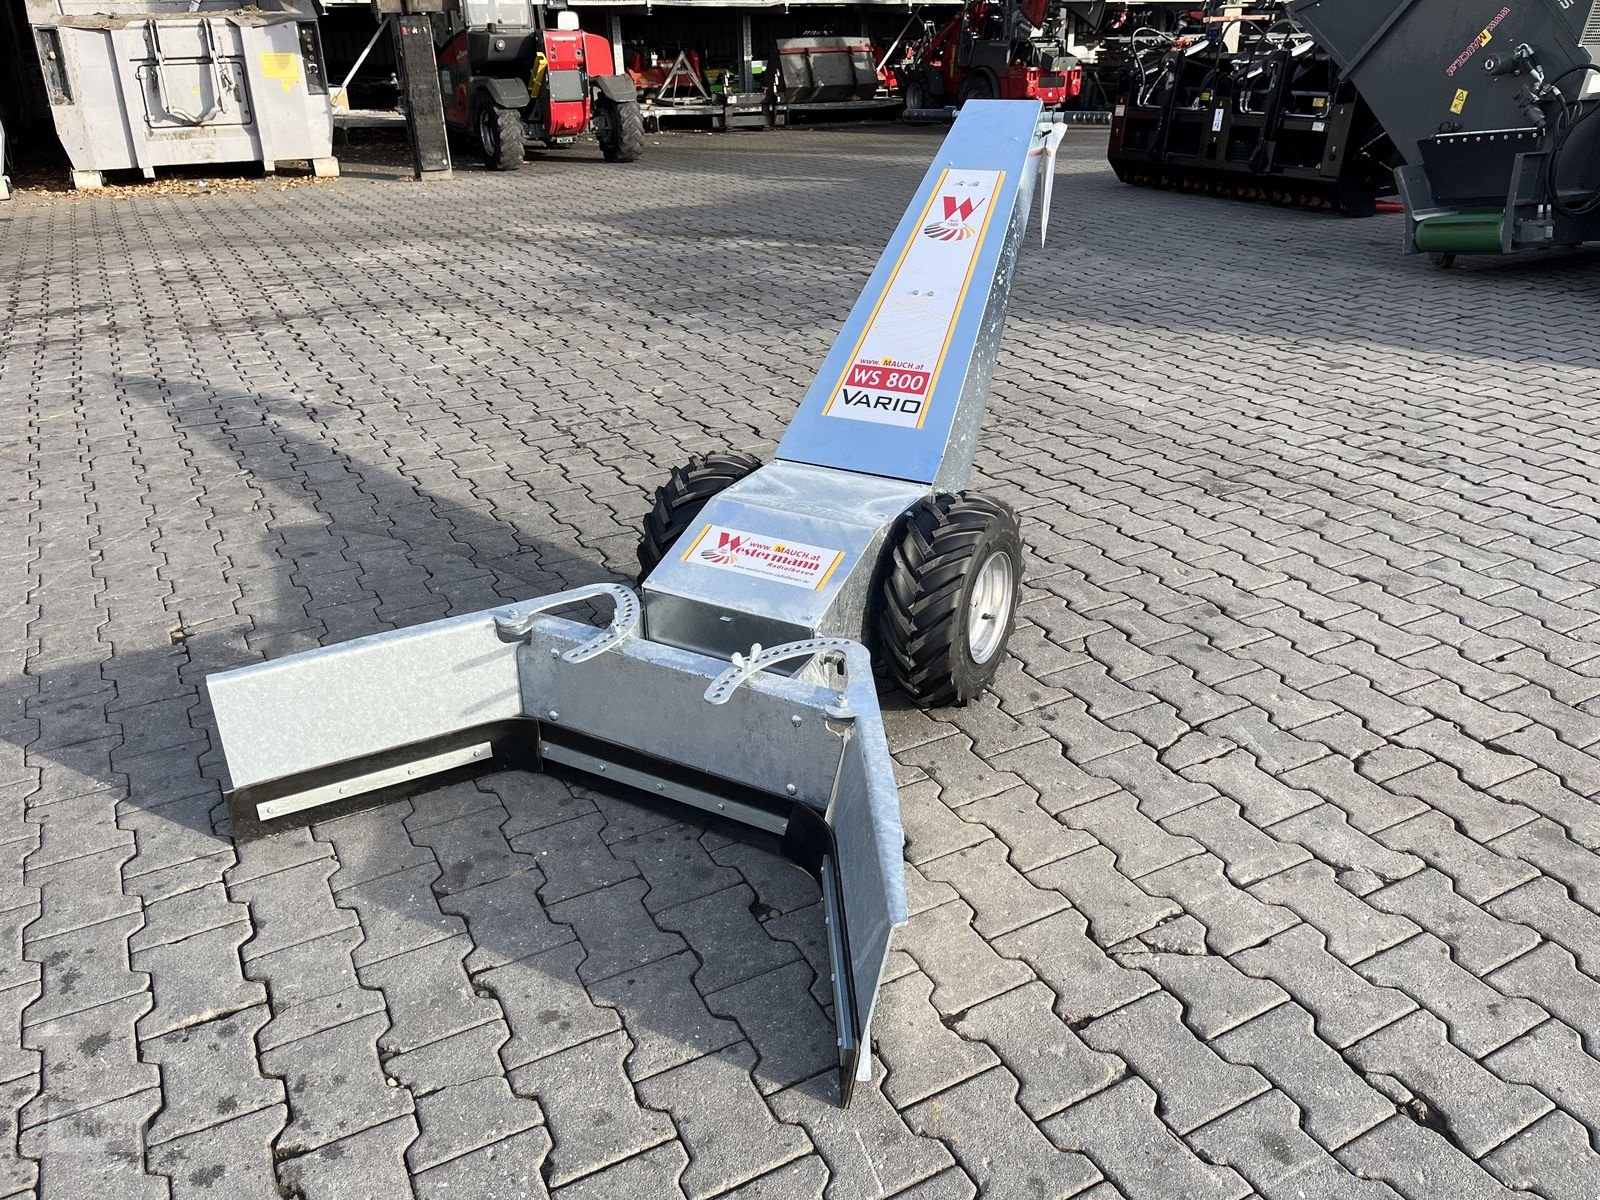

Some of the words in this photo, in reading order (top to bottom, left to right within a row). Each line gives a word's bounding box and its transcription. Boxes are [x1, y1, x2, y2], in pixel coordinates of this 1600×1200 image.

[855, 368, 882, 385] WS
[886, 373, 924, 390] 800
[842, 388, 922, 414] VARIO
[718, 531, 820, 572] Westermann
[767, 562, 815, 576] Radialbesen
